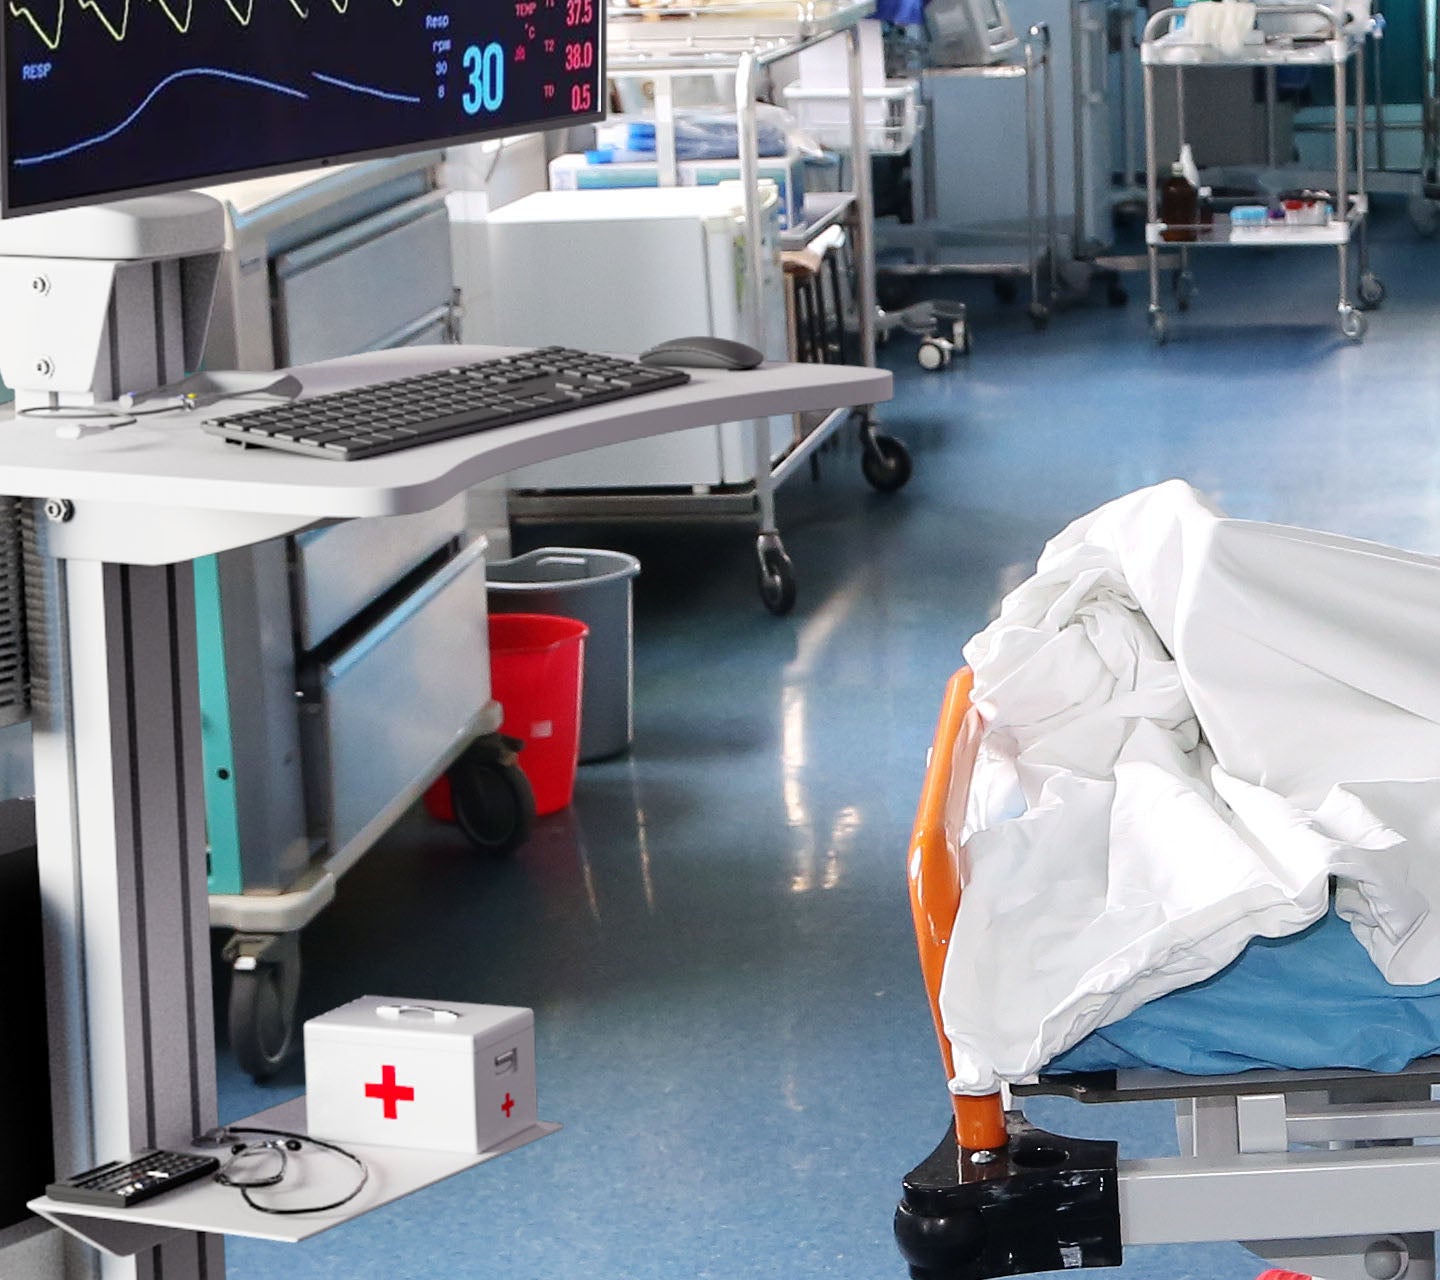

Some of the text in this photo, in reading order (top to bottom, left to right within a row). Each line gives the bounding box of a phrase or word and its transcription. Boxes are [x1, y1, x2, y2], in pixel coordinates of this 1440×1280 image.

[515, 2, 537, 17] TEMP
[433, 39, 451, 54] rpm
[544, 39, 555, 53] T2
[565, 41, 593, 71] 38.0
[22, 62, 52, 81] RESP
[463, 42, 504, 116] 30
[571, 84, 591, 112] 0.5
